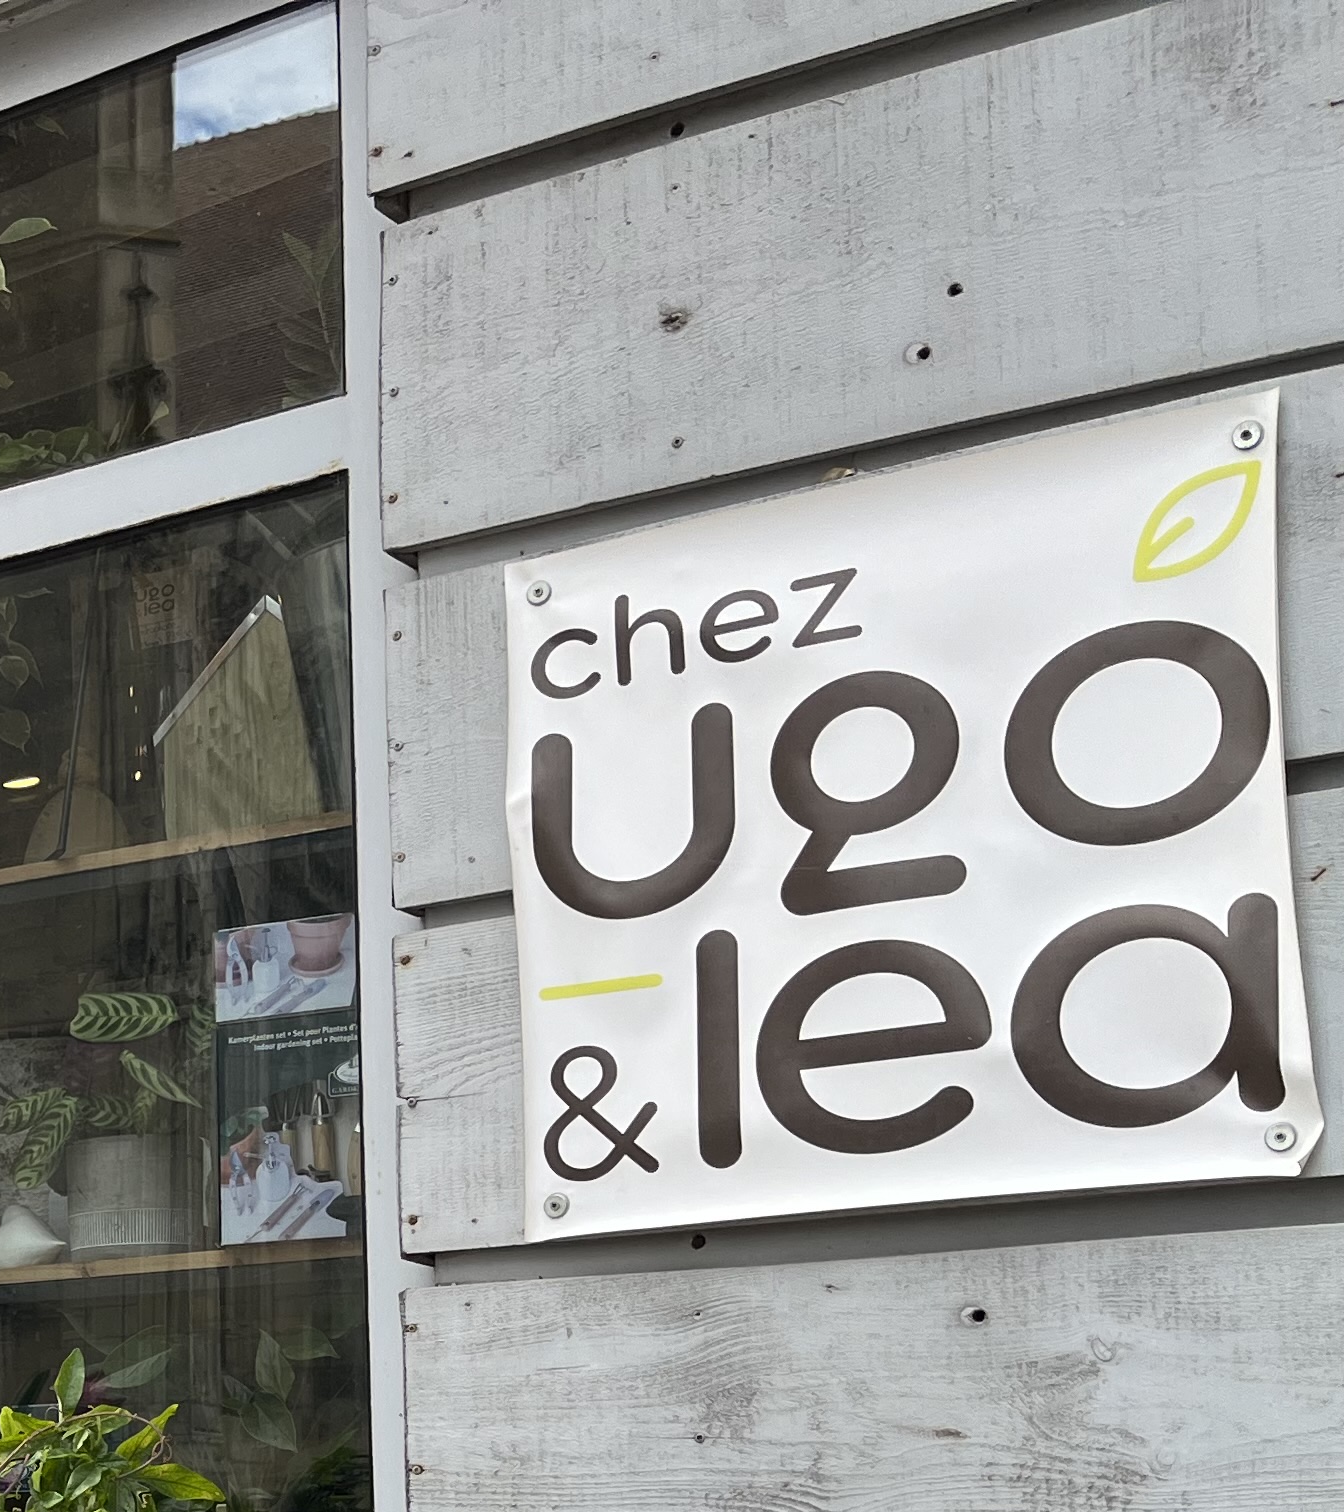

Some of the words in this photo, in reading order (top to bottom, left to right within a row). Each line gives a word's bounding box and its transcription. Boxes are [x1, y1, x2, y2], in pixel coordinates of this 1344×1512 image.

[530, 567, 864, 700] chez
[531, 619, 1272, 921] ugo
[542, 1045, 661, 1183] &
[695, 891, 1288, 1170] lea
